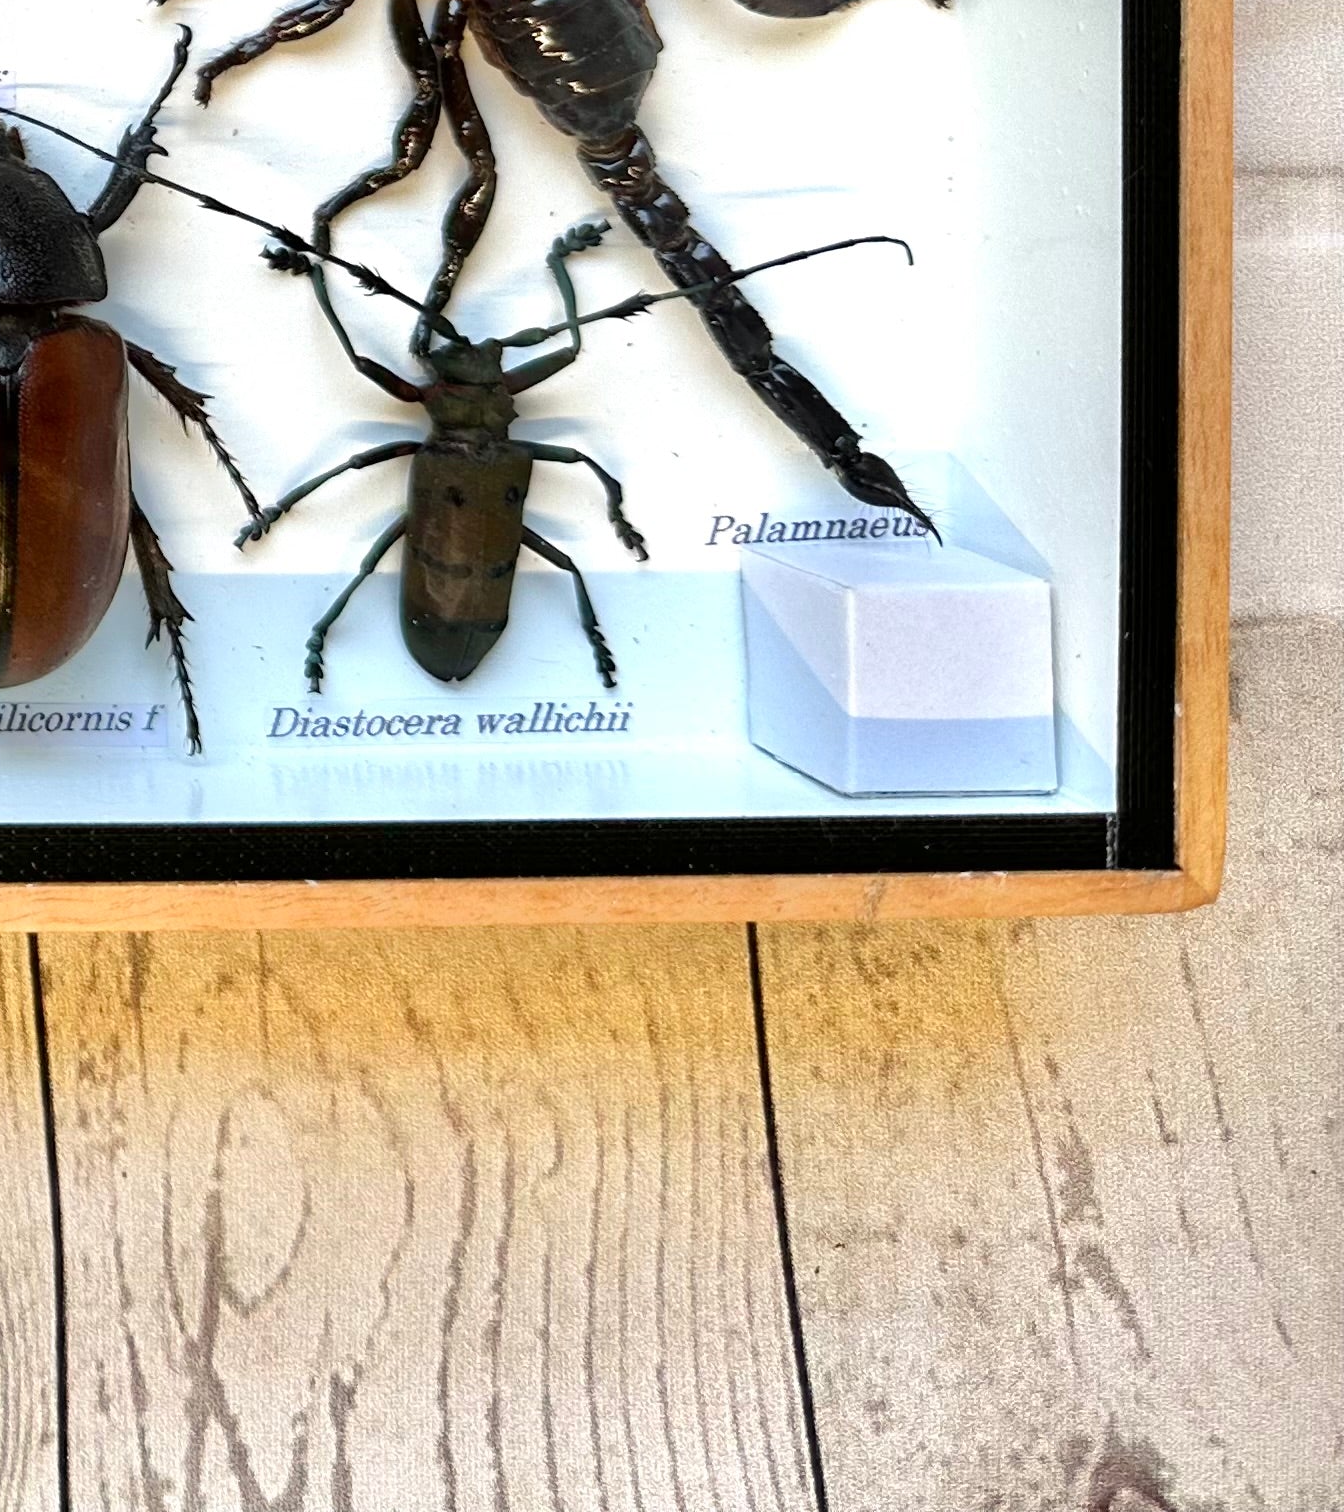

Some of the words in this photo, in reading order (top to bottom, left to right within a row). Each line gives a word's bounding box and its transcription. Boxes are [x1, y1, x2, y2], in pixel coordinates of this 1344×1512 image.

[703, 513, 931, 546] Palamnaeus
[140, 703, 166, 732] f
[264, 706, 461, 738] Diastocera
[476, 702, 634, 735] wallichii
